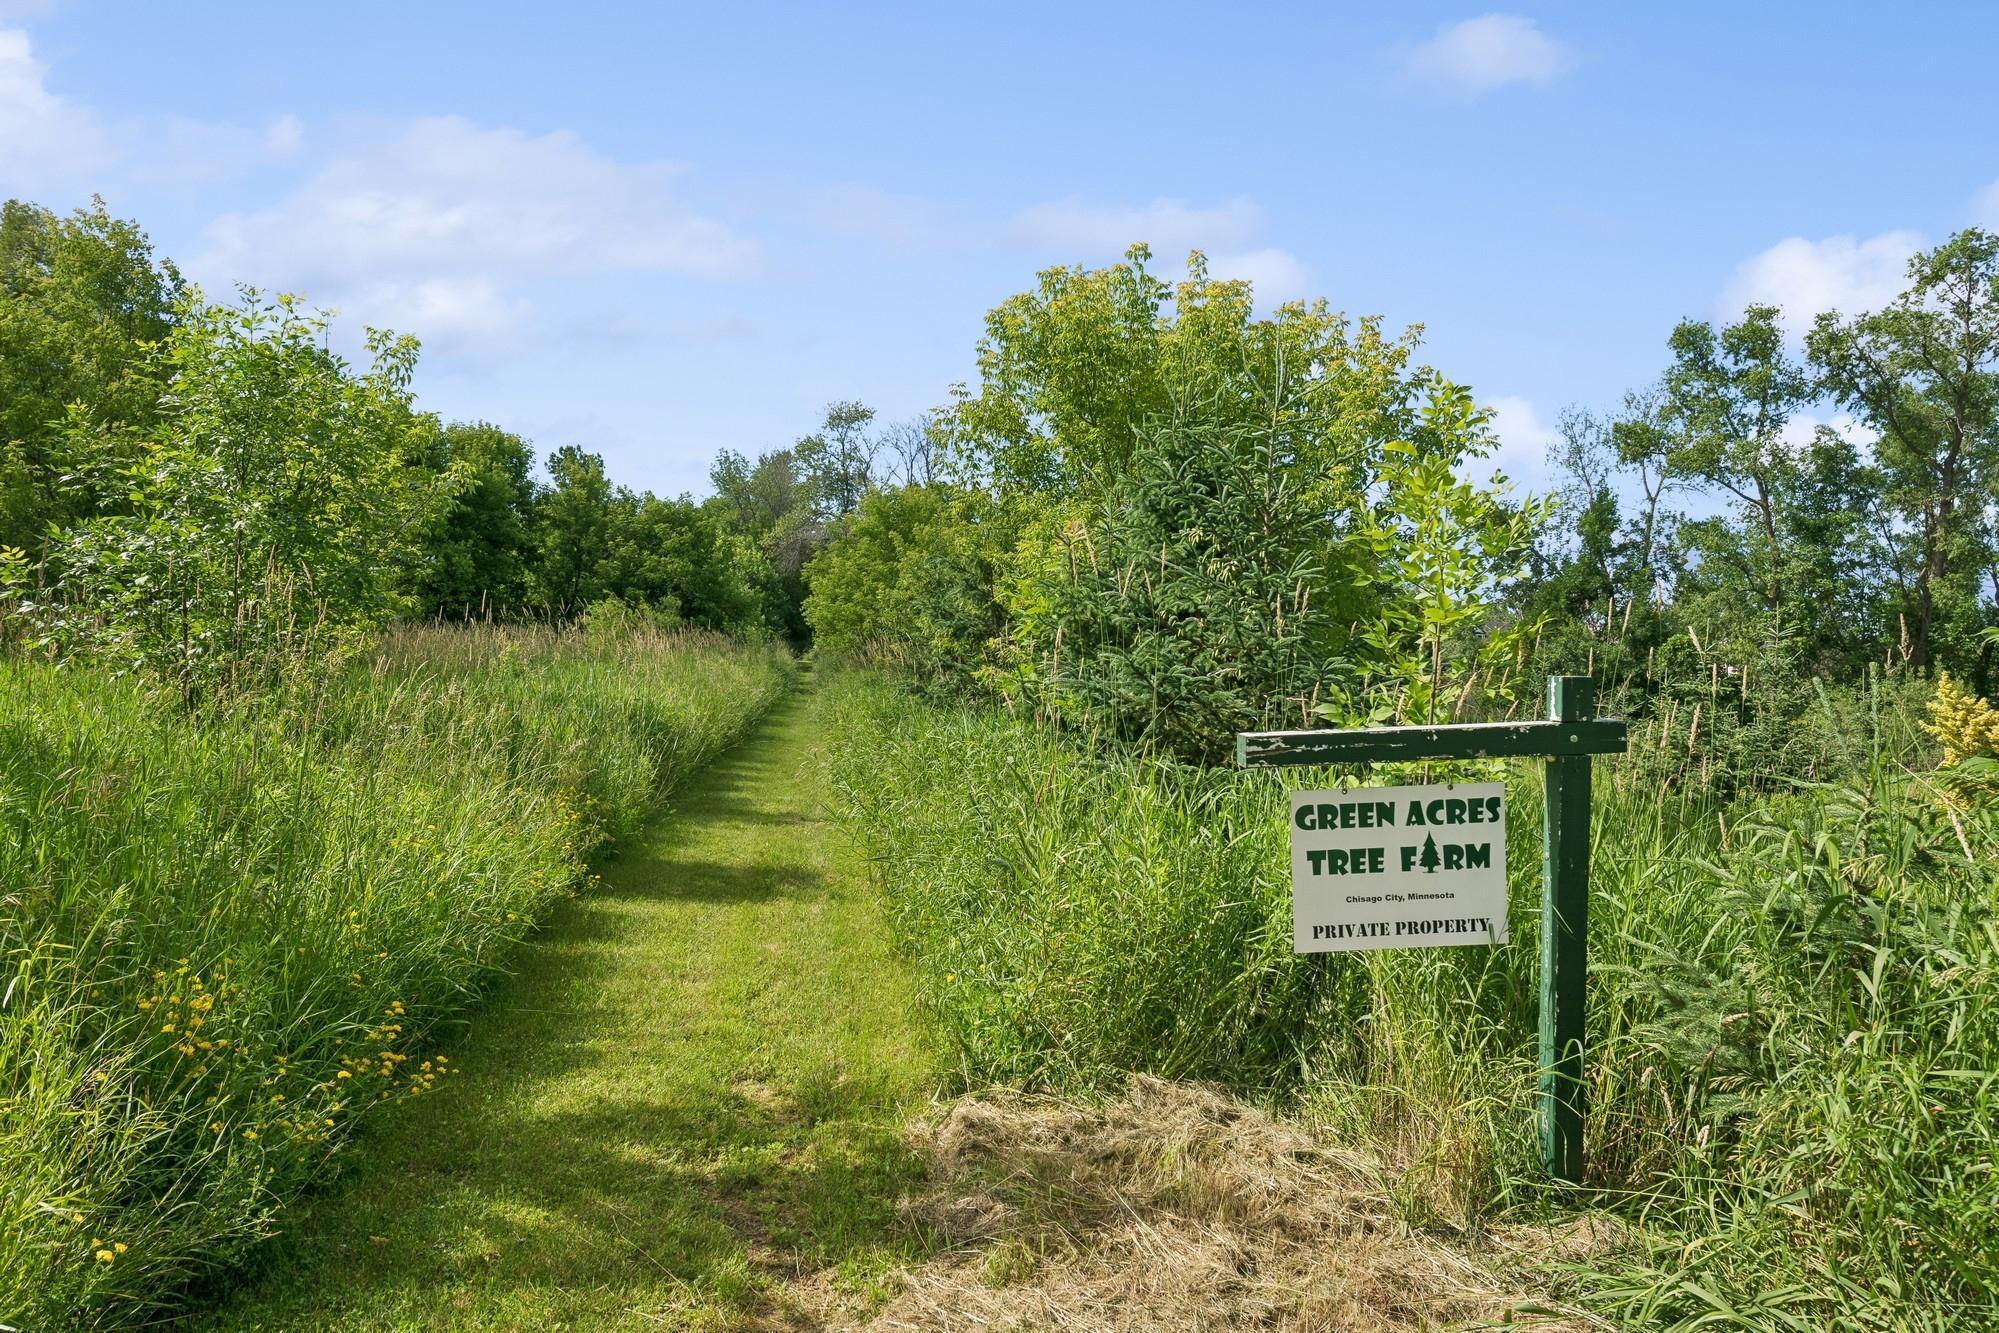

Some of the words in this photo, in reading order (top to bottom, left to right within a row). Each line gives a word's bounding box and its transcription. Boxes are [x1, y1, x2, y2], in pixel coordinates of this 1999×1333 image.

[1295, 801, 1395, 831] GREEN
[1406, 797, 1501, 826] ACRES
[1306, 847, 1385, 876] TREE
[1346, 895, 1383, 903] Chisago
[1385, 893, 1405, 902] City,
[1408, 891, 1455, 901] Minnesota
[1312, 922, 1390, 939] PRIVATE
[1395, 918, 1490, 936] PROPERTY
